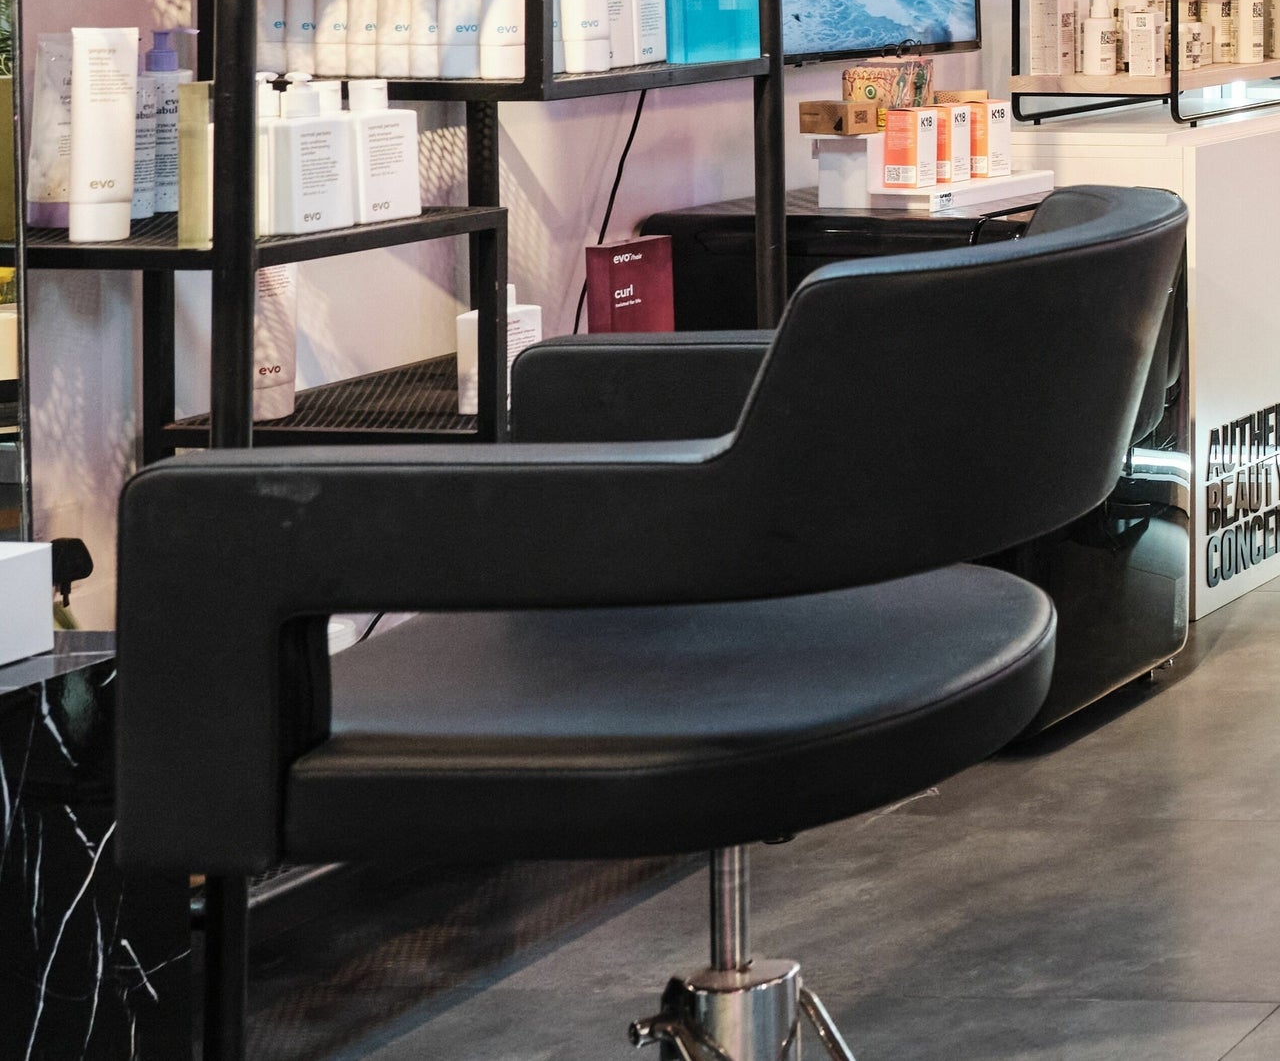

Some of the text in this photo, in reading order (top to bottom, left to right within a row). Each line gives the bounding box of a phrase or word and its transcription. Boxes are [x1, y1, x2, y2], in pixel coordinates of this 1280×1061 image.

[274, 19, 287, 29] ev
[301, 20, 317, 31] ev
[333, 23, 347, 32] ev
[365, 23, 377, 32] ev
[395, 23, 410, 32] ev
[456, 24, 478, 33] evo
[581, 19, 599, 28] evo
[497, 25, 518, 33] evo
[642, 47, 653, 56] evo
[156, 105, 178, 115] abul
[991, 108, 1005, 119] K18
[920, 116, 933, 127] K18
[954, 112, 966, 123] K18
[89, 179, 115, 189] evo
[372, 201, 390, 212] evo
[304, 211, 321, 223] evo
[615, 284, 633, 299] curl
[259, 366, 281, 375] evo
